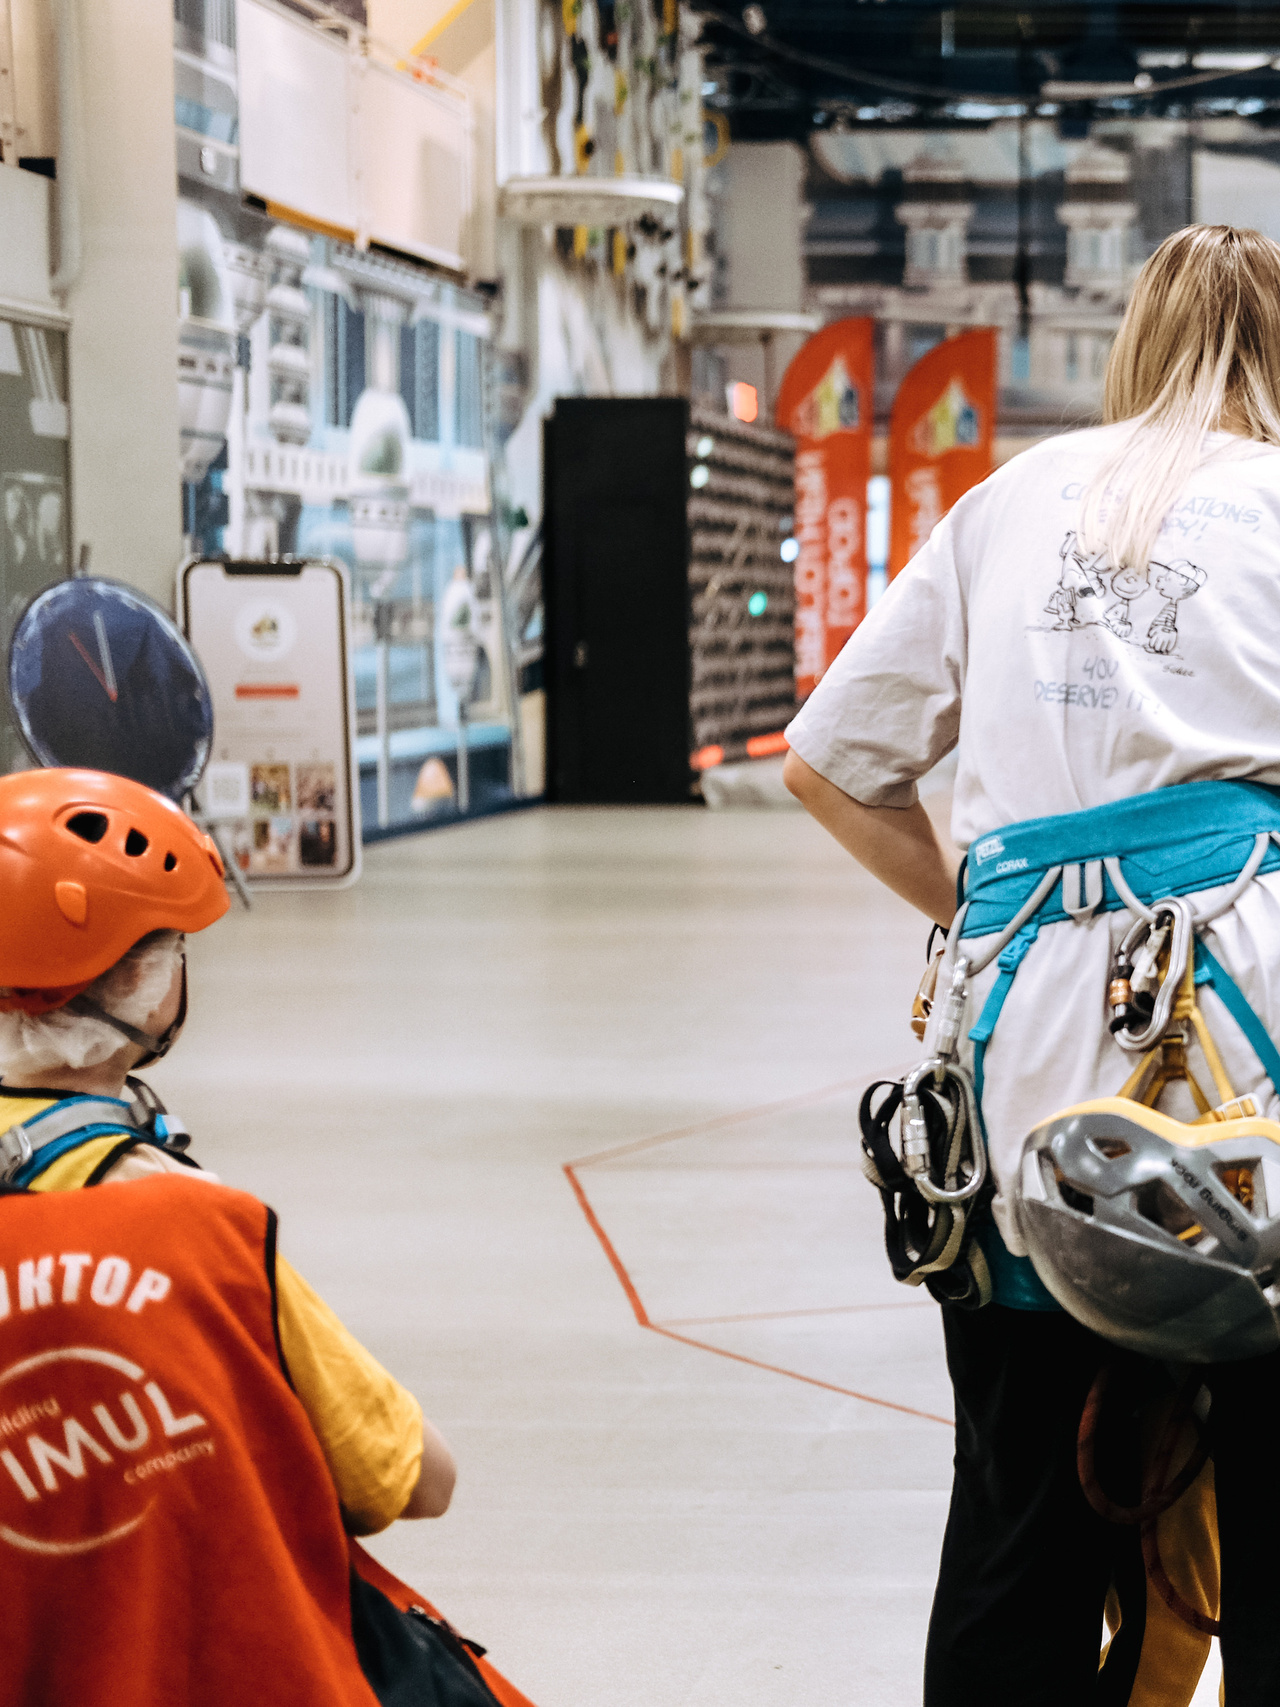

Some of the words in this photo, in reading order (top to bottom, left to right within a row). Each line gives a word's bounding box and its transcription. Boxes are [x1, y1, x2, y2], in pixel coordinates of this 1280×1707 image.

[1082, 657, 1119, 681] YOU
[996, 857, 1029, 874] CORAX
[0, 1380, 207, 1502] IMUL
